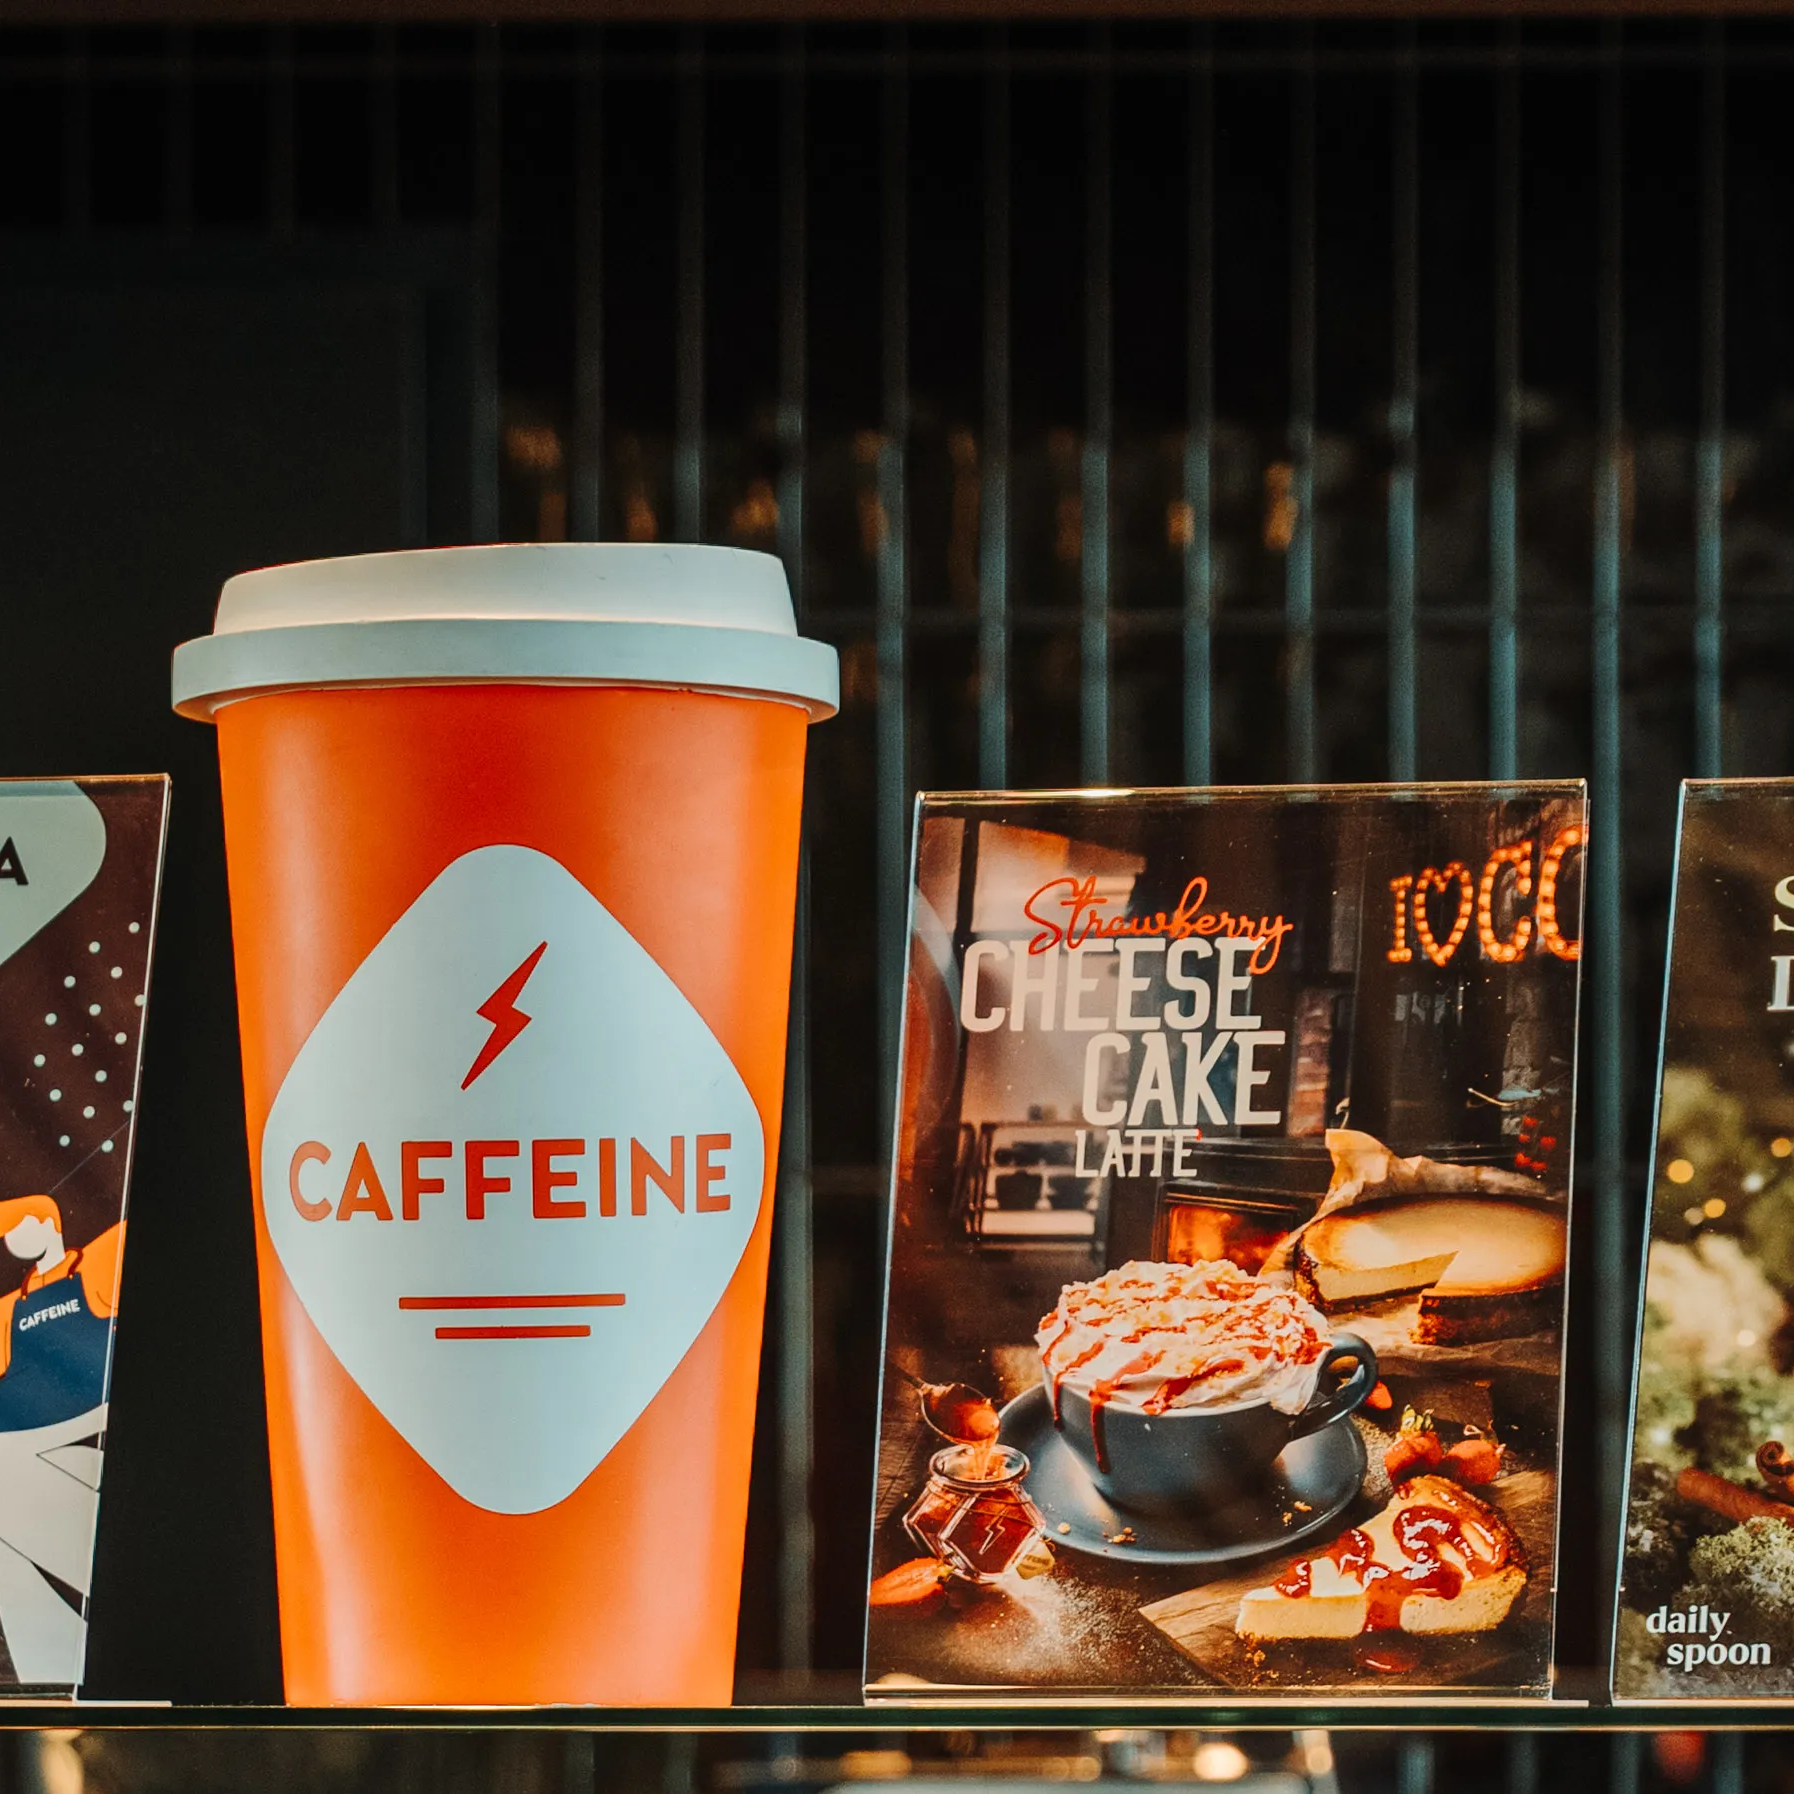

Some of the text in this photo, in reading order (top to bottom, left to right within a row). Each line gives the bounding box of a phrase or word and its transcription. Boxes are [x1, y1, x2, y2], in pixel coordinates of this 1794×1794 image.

[1023, 876, 1293, 975] Strawberry
[960, 937, 1266, 1032] CHEESE
[1081, 1031, 1285, 1126] CAKE
[289, 1133, 732, 1222] CAFFEINE
[1074, 1128, 1199, 1179] LATTE
[19, 1299, 80, 1331] CAFFEINE
[1646, 1605, 1731, 1641] daily
[1667, 1643, 1771, 1672] spoon
